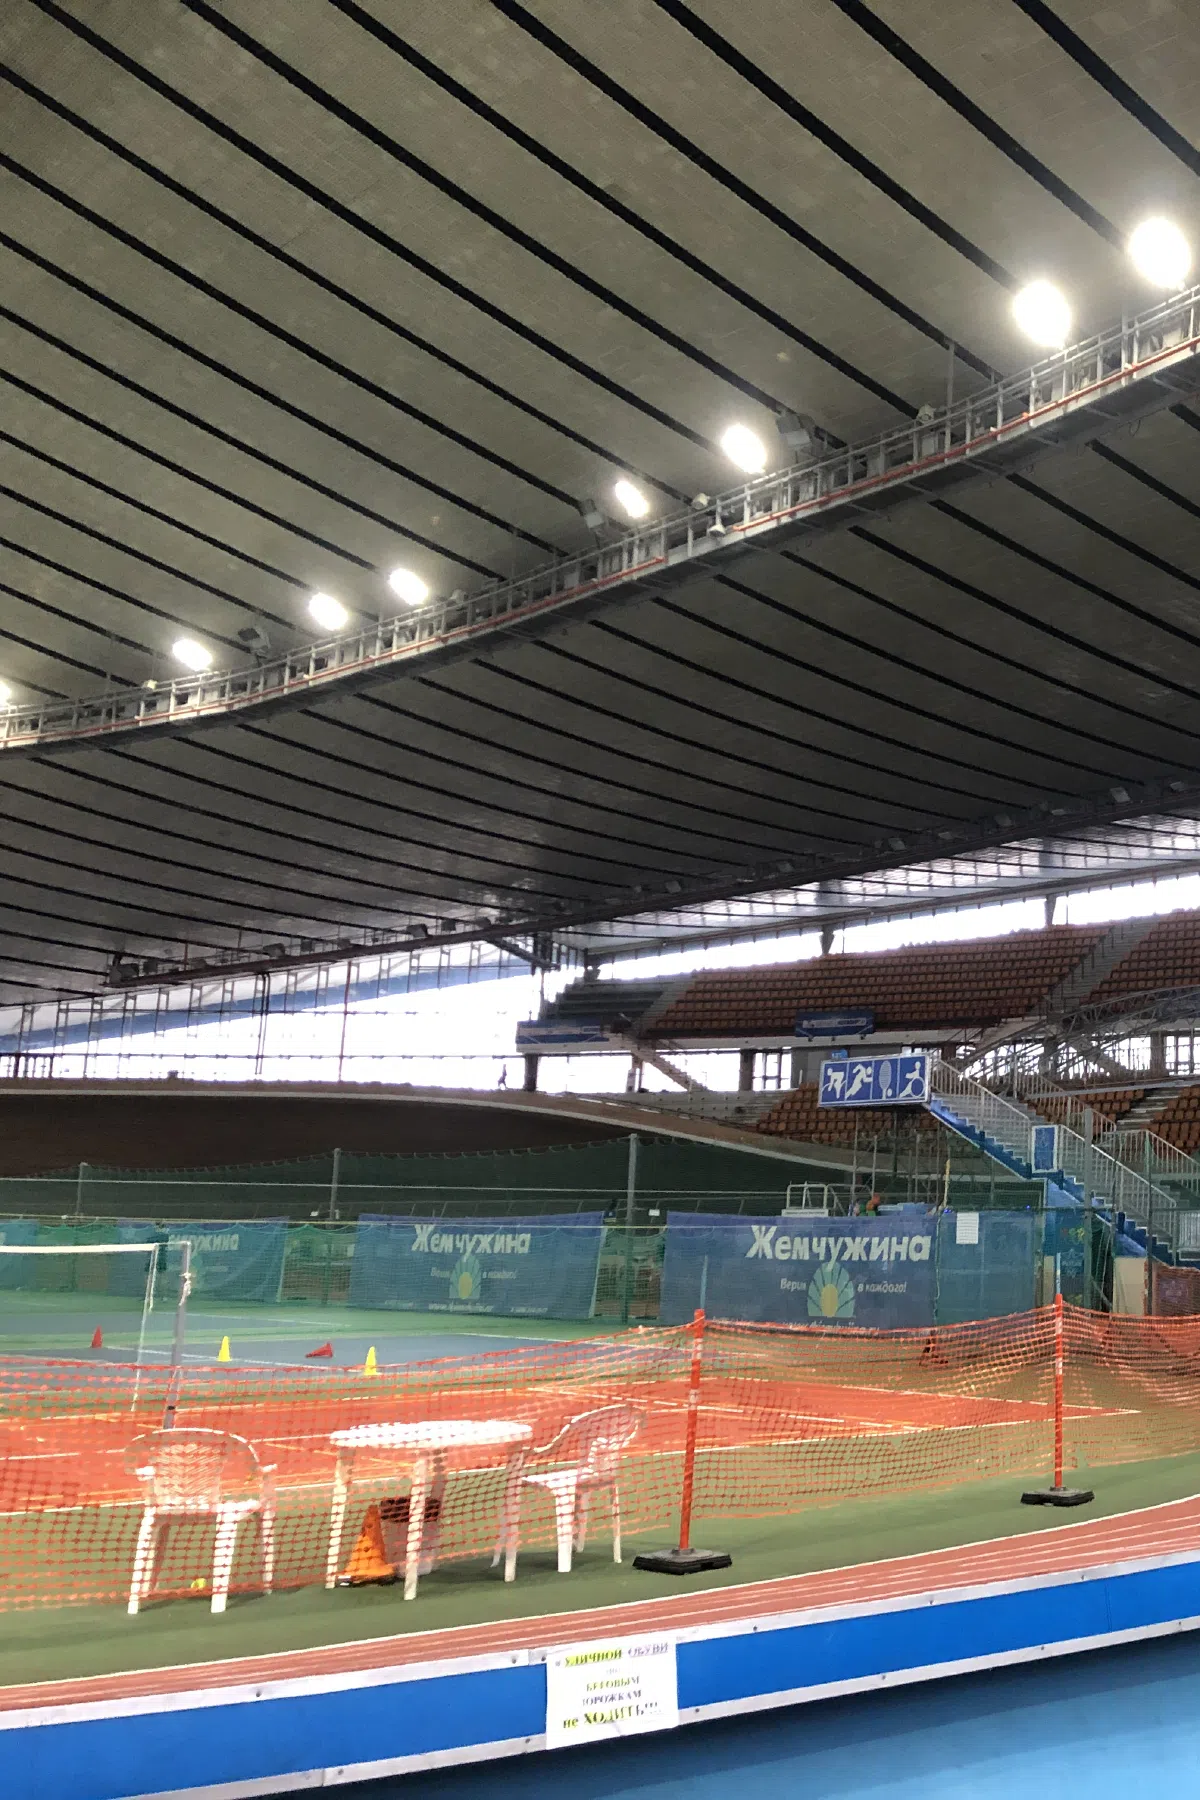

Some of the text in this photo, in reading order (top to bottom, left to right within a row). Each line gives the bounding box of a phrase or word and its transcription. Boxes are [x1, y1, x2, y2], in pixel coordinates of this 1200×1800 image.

[412, 1224, 531, 1262] Жемчужина
[745, 1225, 932, 1271] Жемчужина
[857, 1283, 864, 1292] в
[866, 1281, 907, 1293] каждого!
[565, 1648, 622, 1667] УЛИЧНОЙ
[563, 1717, 579, 1728] не
